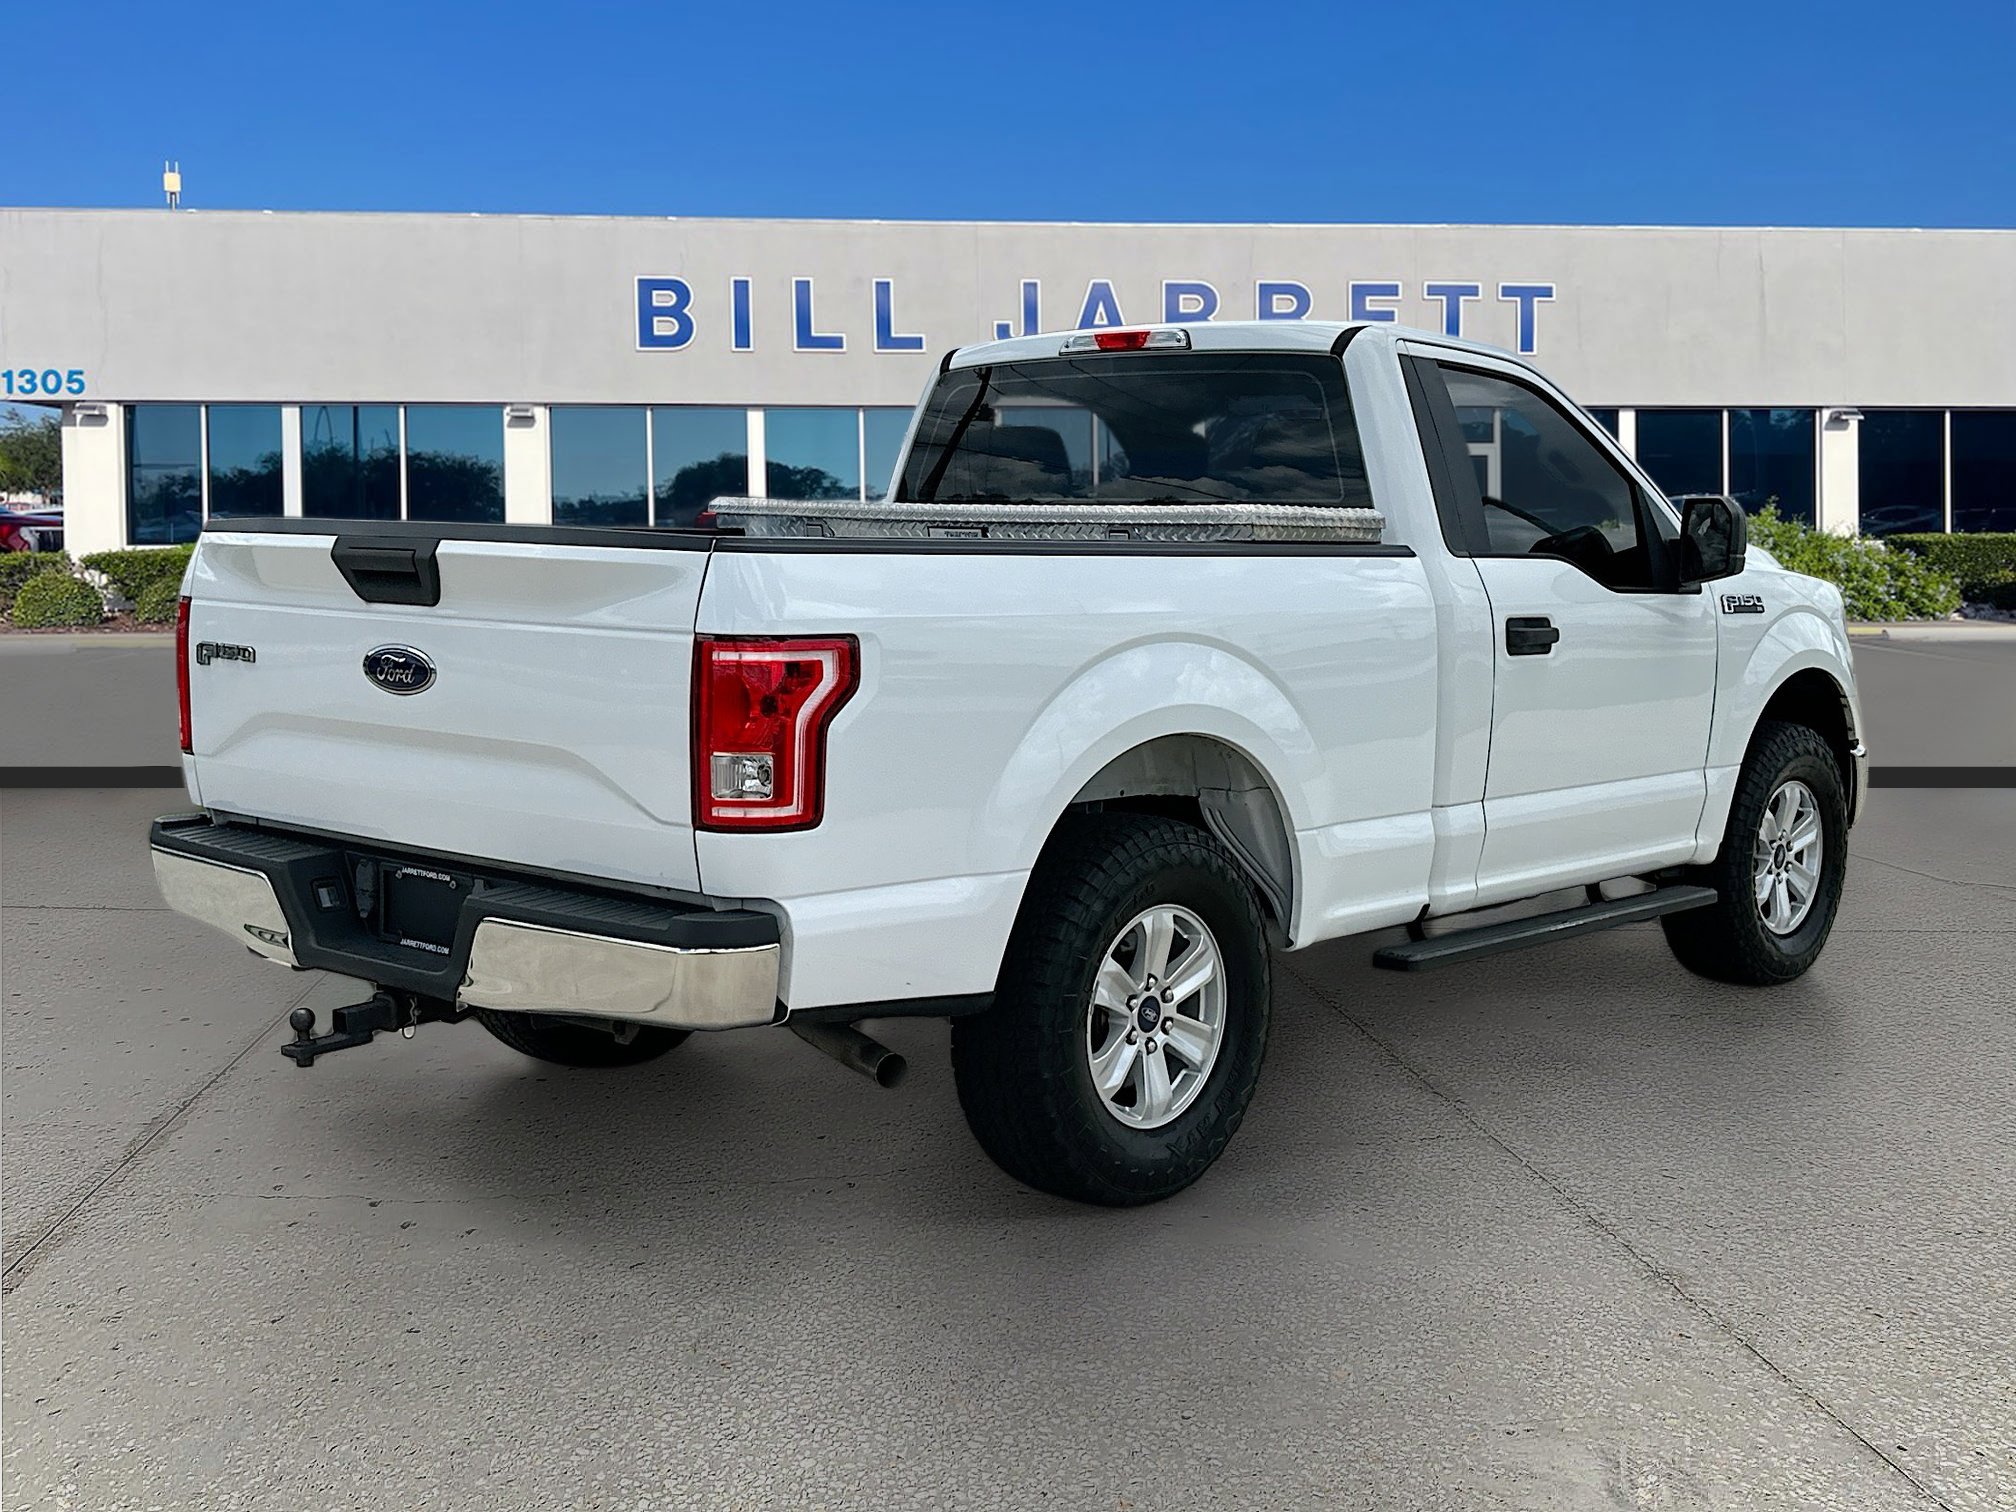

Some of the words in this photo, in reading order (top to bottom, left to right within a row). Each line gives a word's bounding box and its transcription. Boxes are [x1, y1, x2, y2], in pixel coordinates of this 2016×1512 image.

[634, 275, 926, 352] BILL
[993, 279, 1556, 356] JARRETT
[1, 369, 85, 394] 1305
[376, 654, 416, 684] Ford
[401, 867, 451, 881] JARRETTFORD.COM
[400, 938, 450, 954] JARRETTFORD.COM
